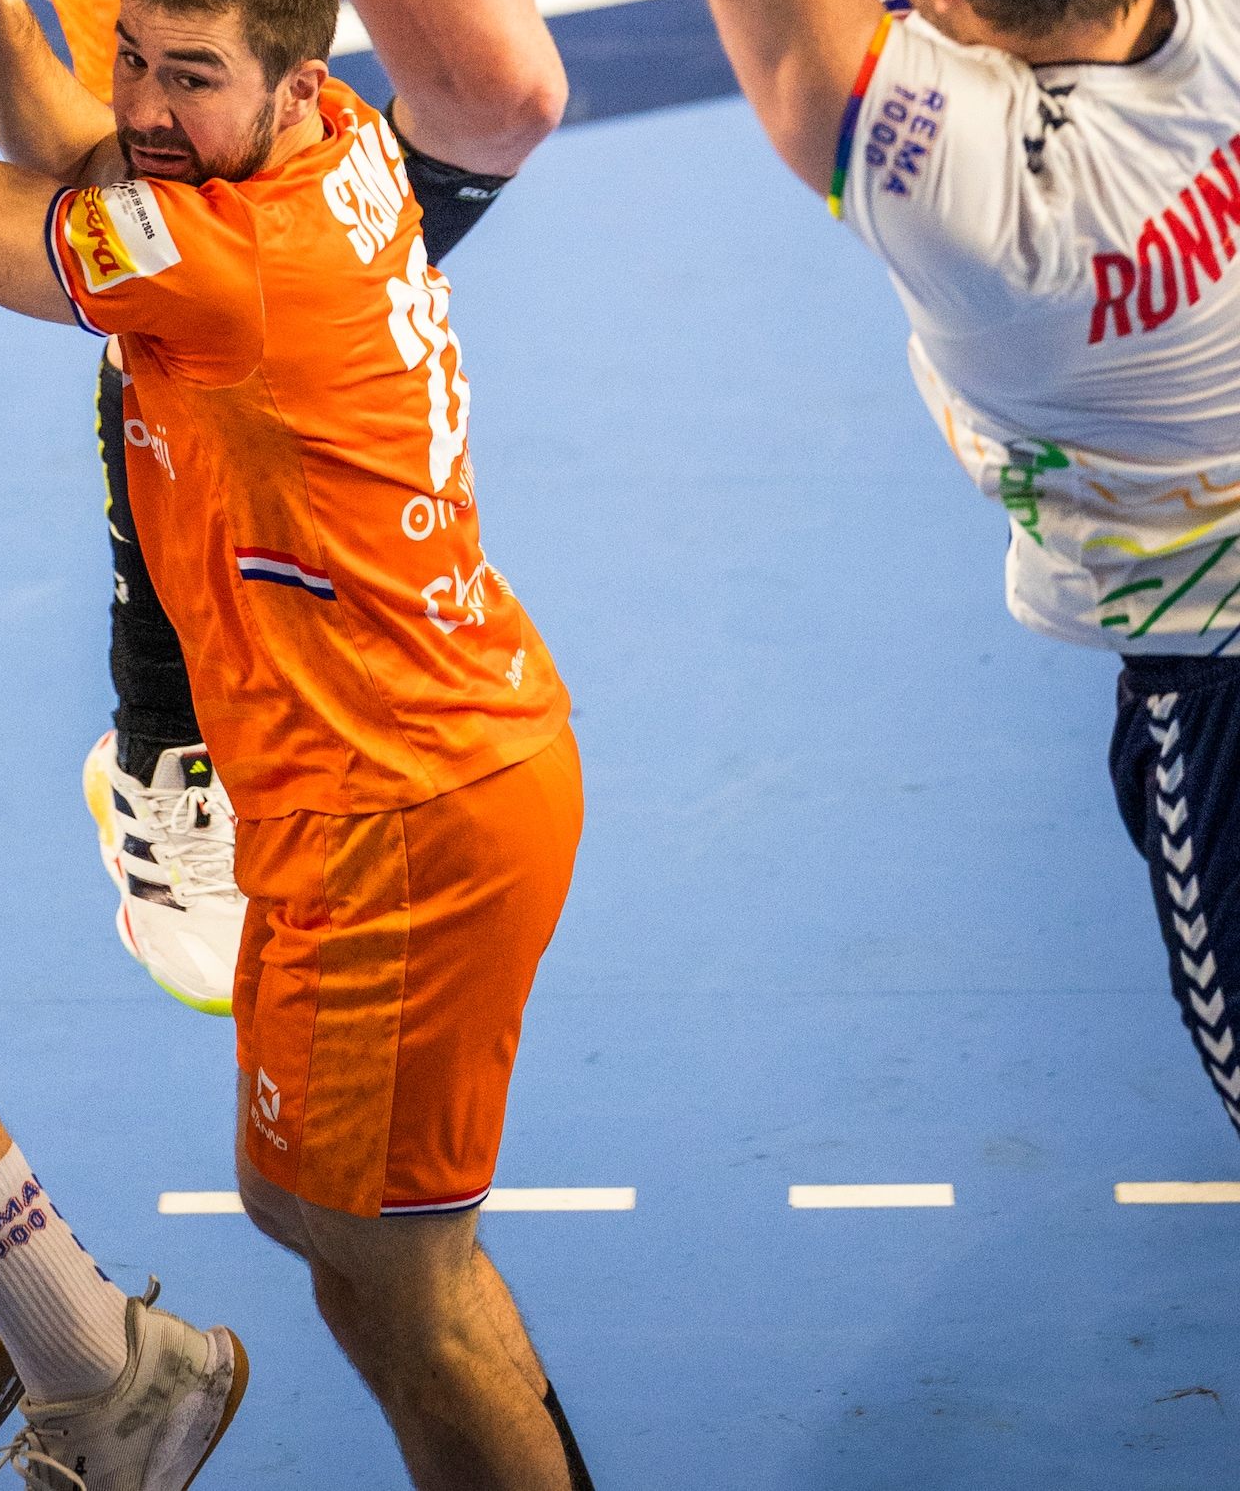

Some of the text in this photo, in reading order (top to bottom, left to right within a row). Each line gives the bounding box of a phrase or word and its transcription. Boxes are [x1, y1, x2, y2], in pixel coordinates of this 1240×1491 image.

[864, 83, 916, 171] 1000
[883, 88, 945, 198] REMA
[141, 220, 155, 240] 2026
